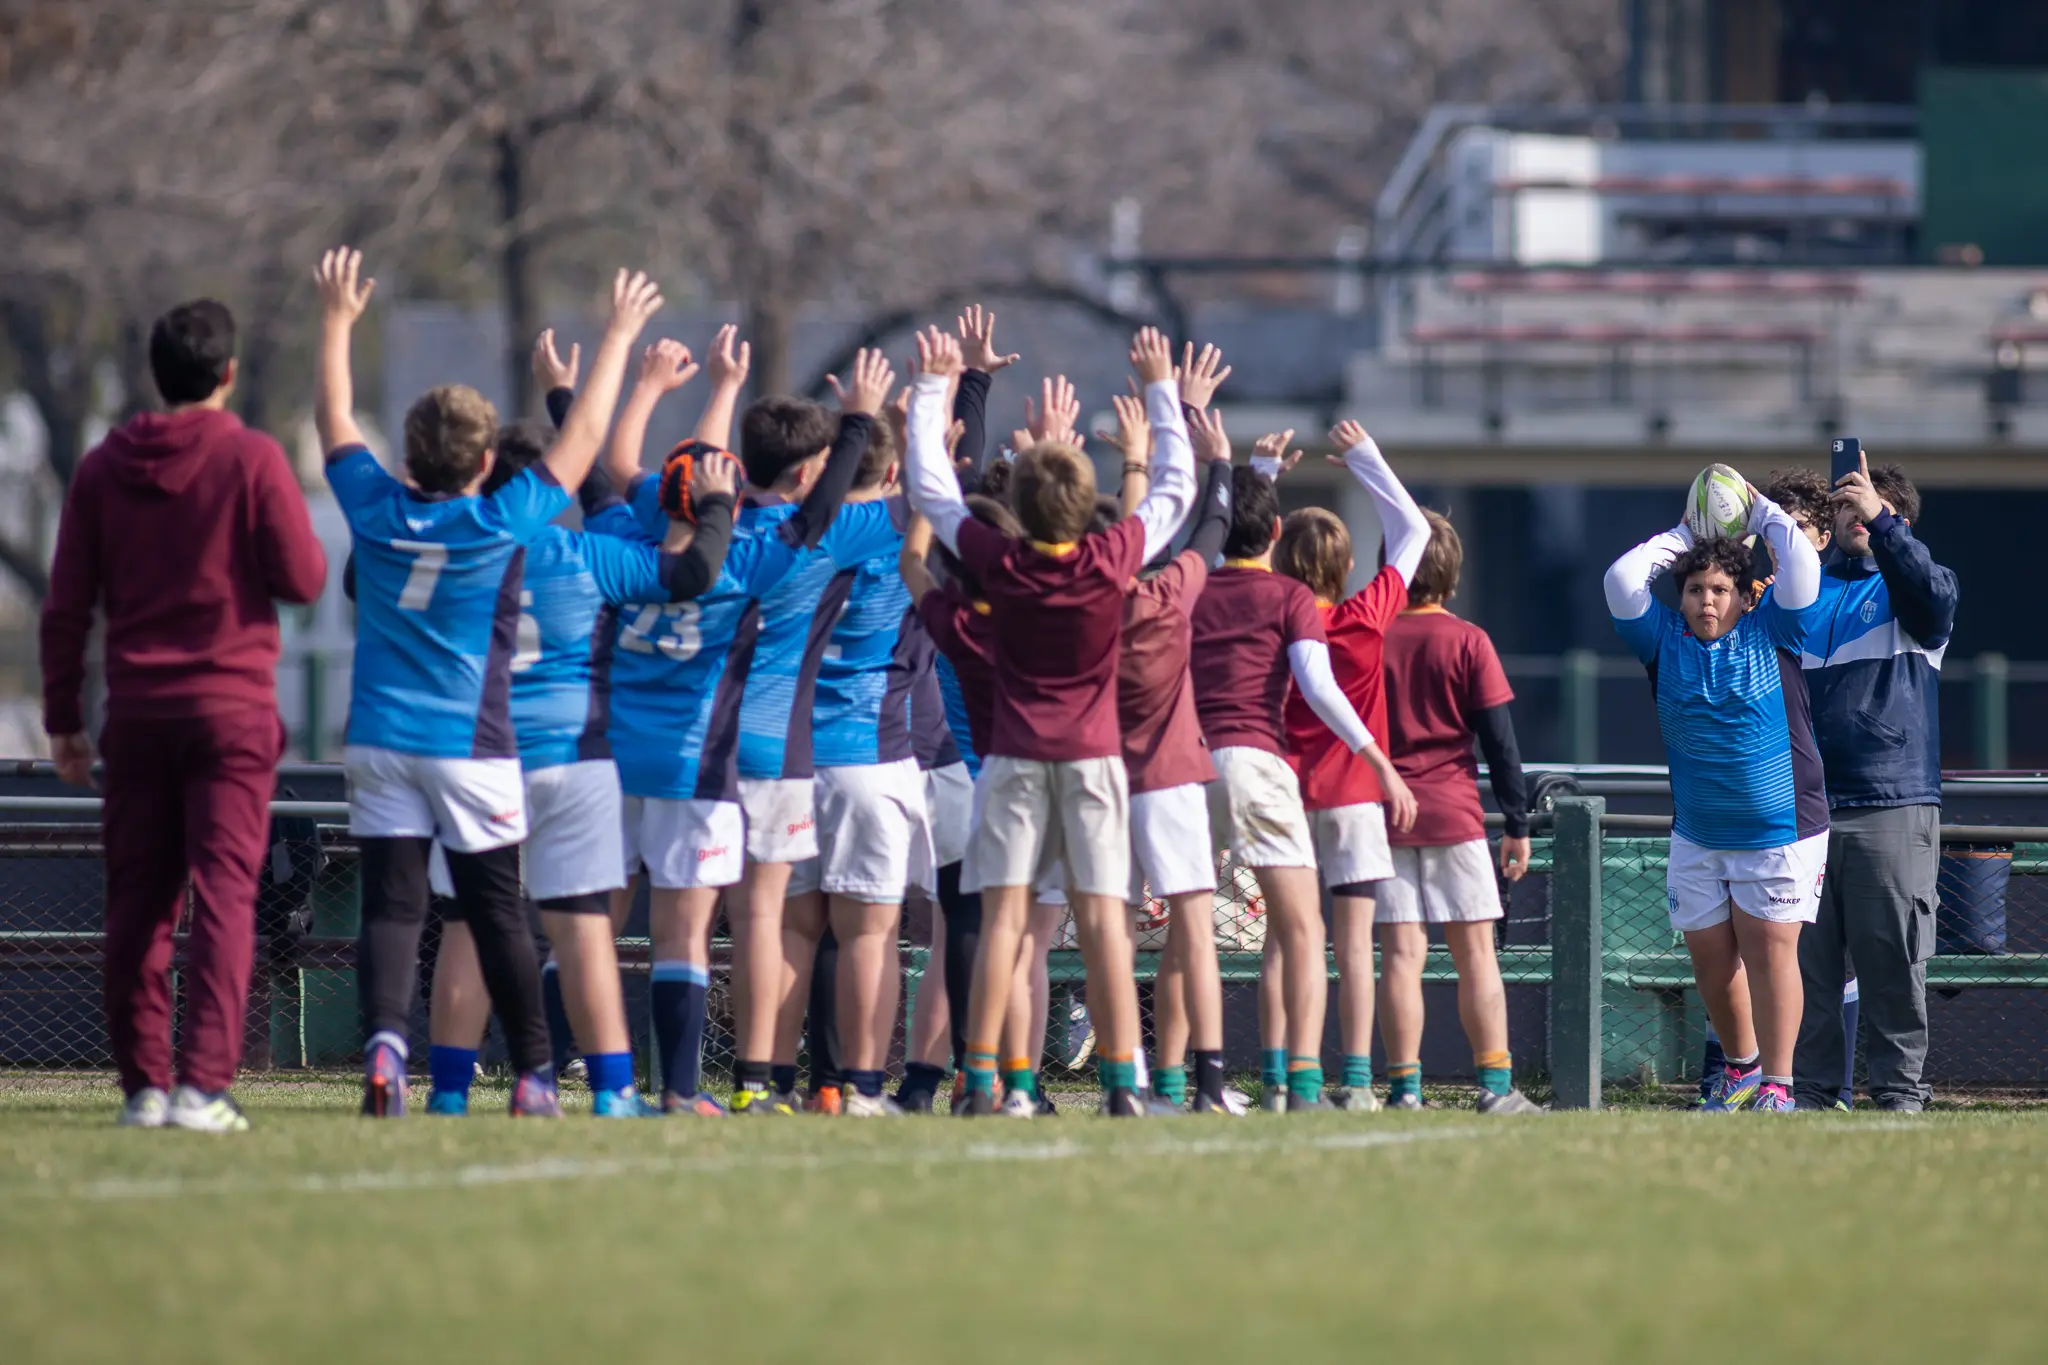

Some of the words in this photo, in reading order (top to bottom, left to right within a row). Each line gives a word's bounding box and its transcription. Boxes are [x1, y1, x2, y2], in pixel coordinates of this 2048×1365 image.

[390, 538, 448, 611] 7
[618, 602, 702, 662] 23
[1769, 896, 1801, 905] WALKER
